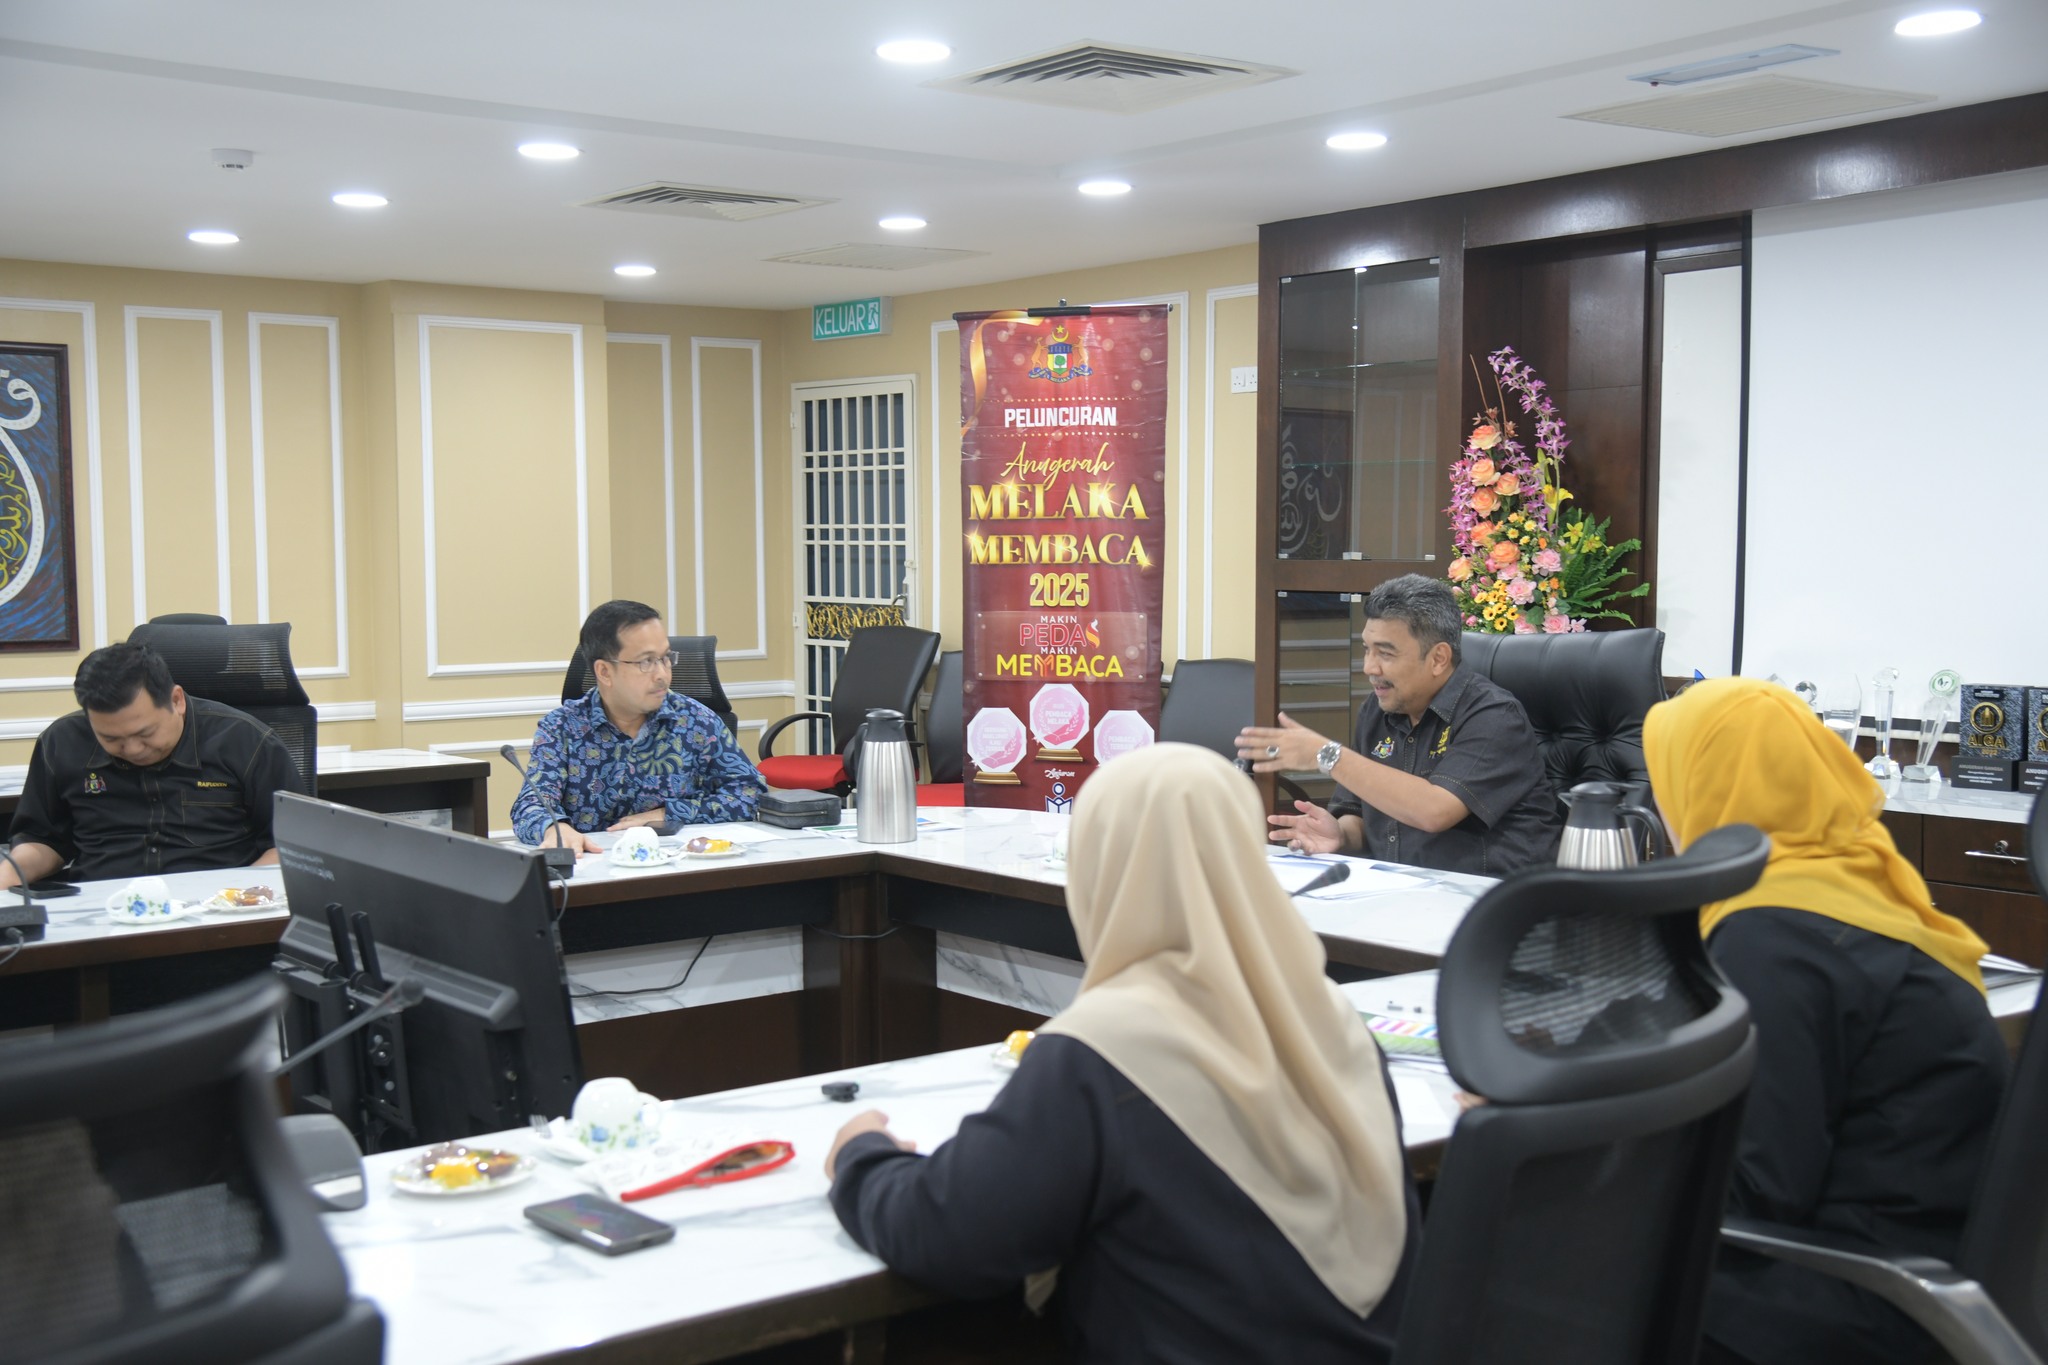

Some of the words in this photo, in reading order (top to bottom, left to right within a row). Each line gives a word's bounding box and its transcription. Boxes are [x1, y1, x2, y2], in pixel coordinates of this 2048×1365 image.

[815, 304, 866, 335] KELUAR
[1004, 406, 1117, 428] PELUNCURAN
[1000, 441, 1116, 489] Anugerah
[968, 481, 1149, 521] MELAKA
[969, 533, 1150, 566] MEMBACA
[1029, 572, 1090, 607] 2025
[1019, 619, 1101, 649] PEDAS
[1040, 615, 1078, 624] MAKIN
[1040, 646, 1078, 655] MAKIN
[996, 654, 1124, 678] MEMBACA
